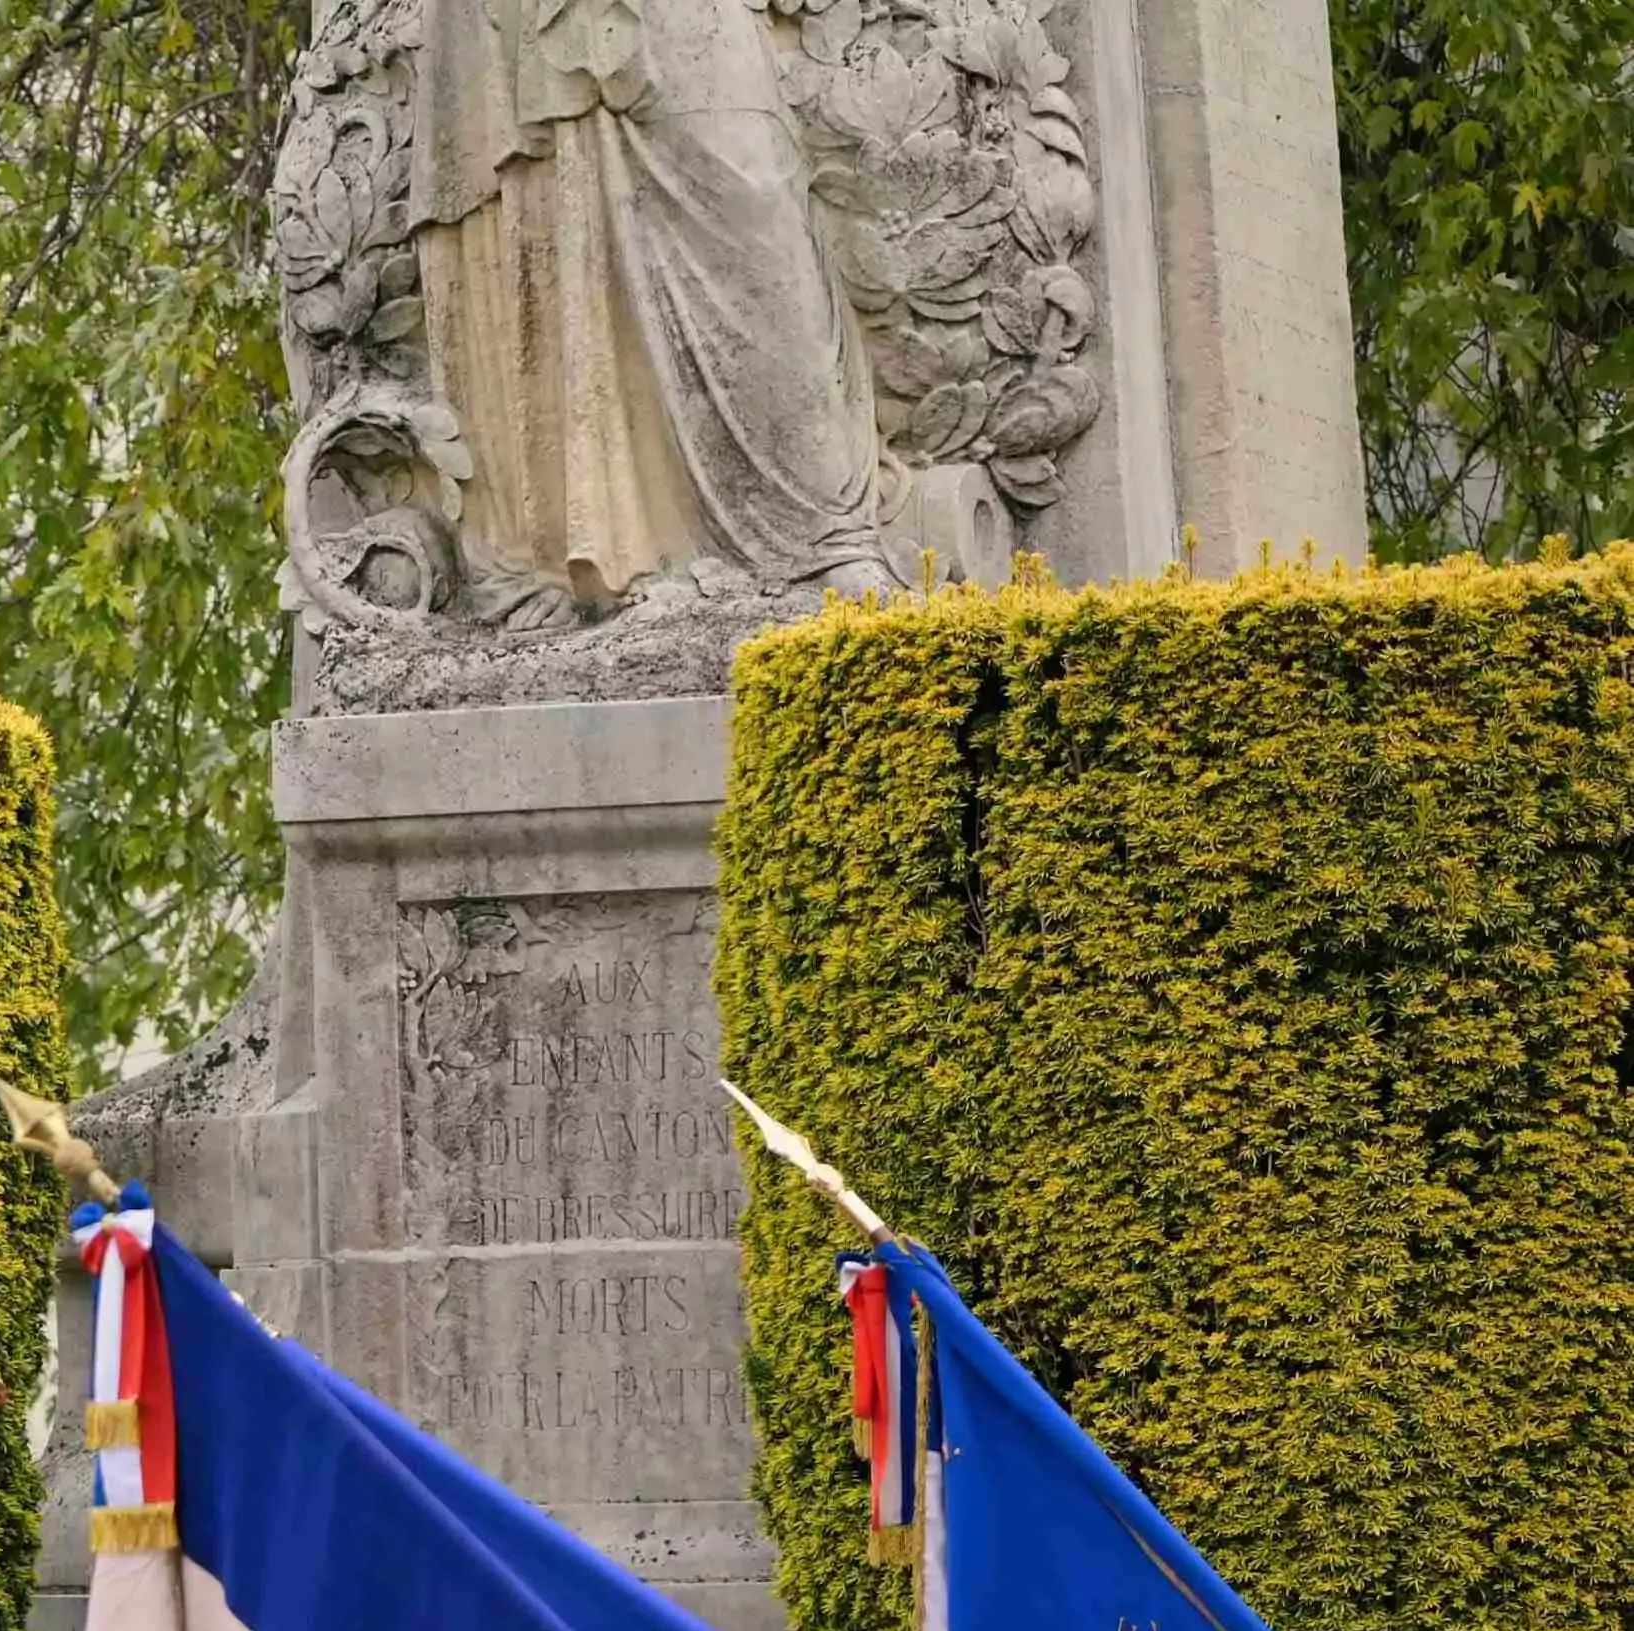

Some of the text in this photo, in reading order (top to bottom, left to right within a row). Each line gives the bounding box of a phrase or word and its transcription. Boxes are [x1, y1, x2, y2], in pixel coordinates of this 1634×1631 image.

[562, 960, 651, 1006] AUX
[510, 1030, 707, 1088] ENFANTS
[487, 1109, 731, 1166] DU CANTON
[480, 1190, 741, 1245] DE BRESSUIRE
[530, 1275, 689, 1336] MORTS
[555, 1371, 602, 1429] LA
[611, 1367, 748, 1426] PATRI
